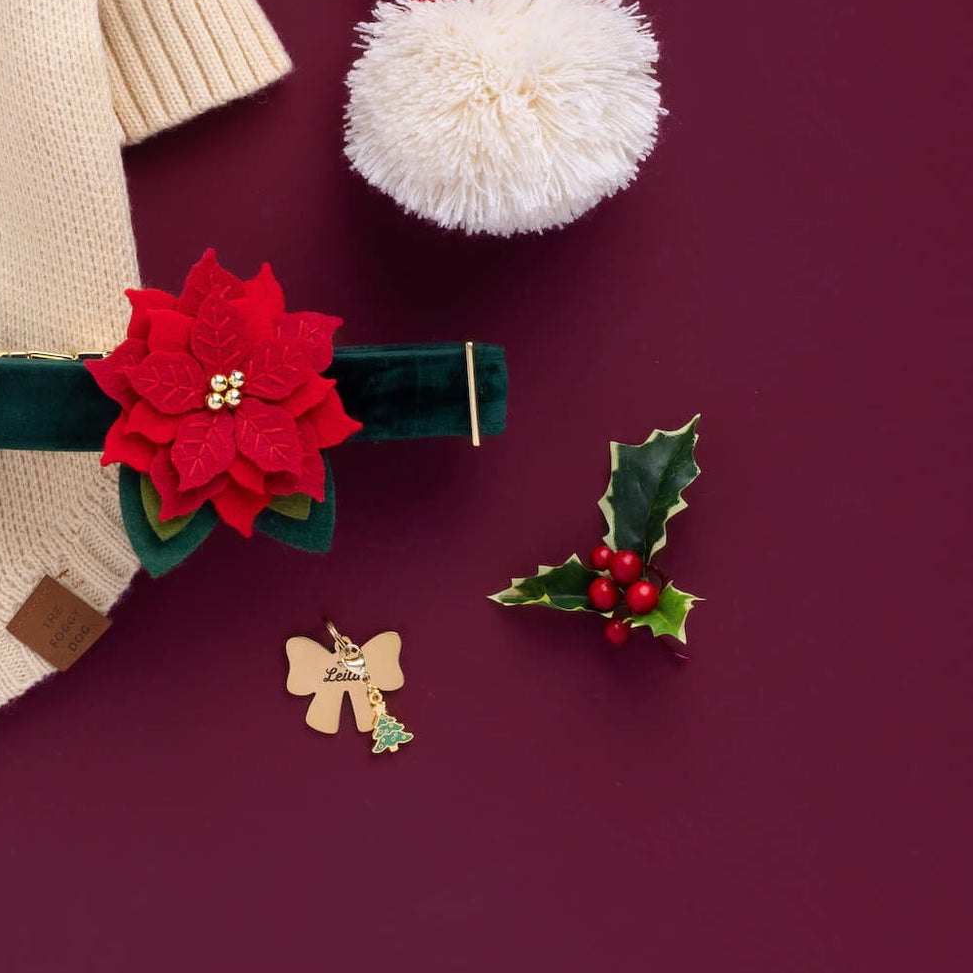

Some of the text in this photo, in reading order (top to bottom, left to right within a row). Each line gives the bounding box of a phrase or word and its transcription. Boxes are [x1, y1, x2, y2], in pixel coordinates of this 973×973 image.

[42, 605, 63, 628] THE
[49, 609, 82, 649] FOGGY
[68, 625, 91, 652] DOG
